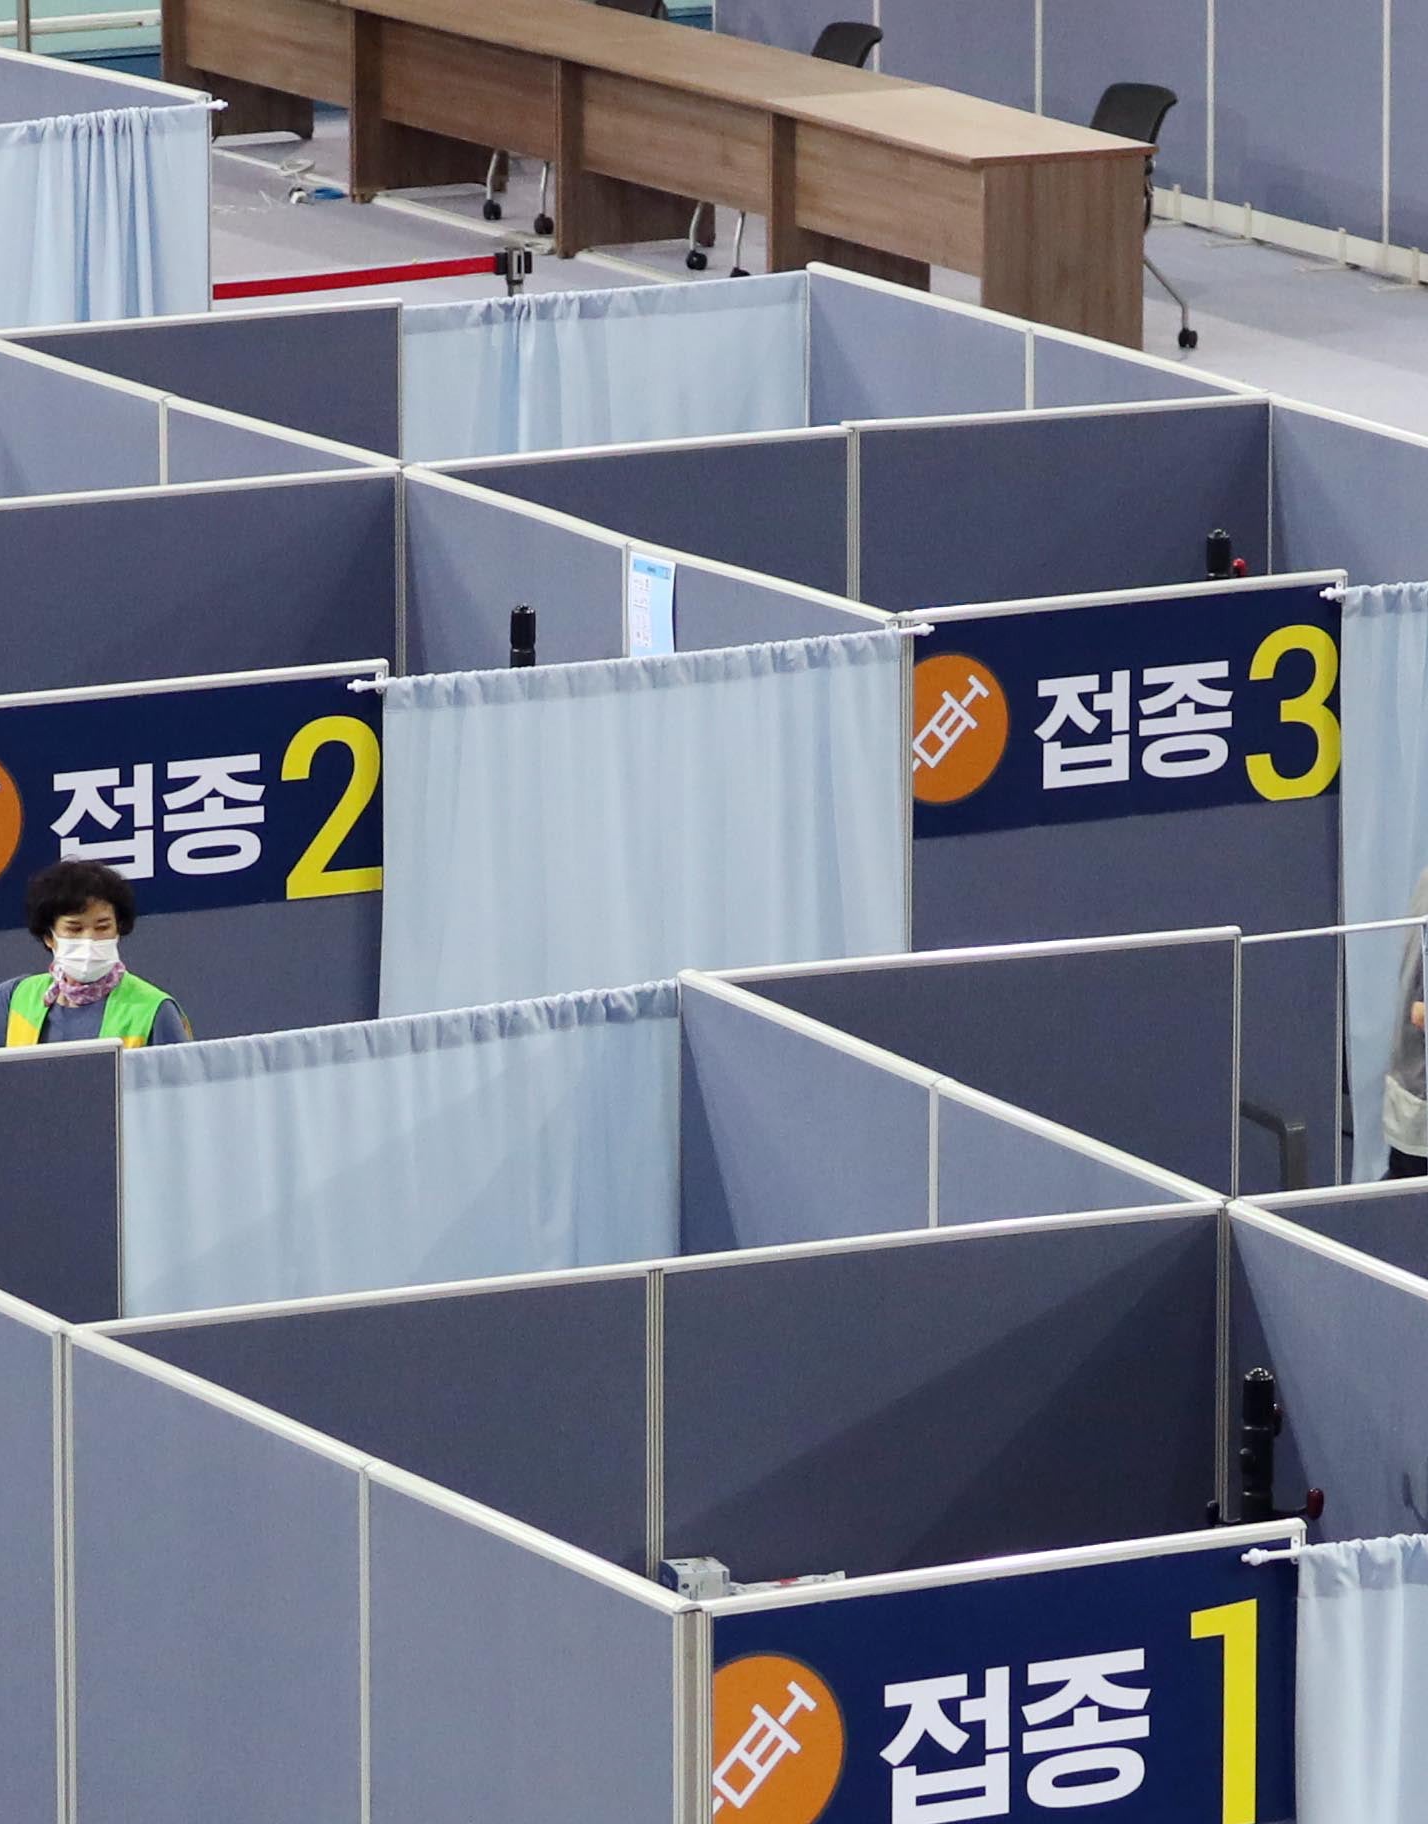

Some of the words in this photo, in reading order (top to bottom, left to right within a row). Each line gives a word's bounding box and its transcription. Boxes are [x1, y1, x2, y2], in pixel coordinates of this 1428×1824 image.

[1034, 660, 1232, 790] 접종
[1247, 625, 1341, 801] 3
[50, 753, 266, 879] 접종
[281, 716, 383, 899] 2
